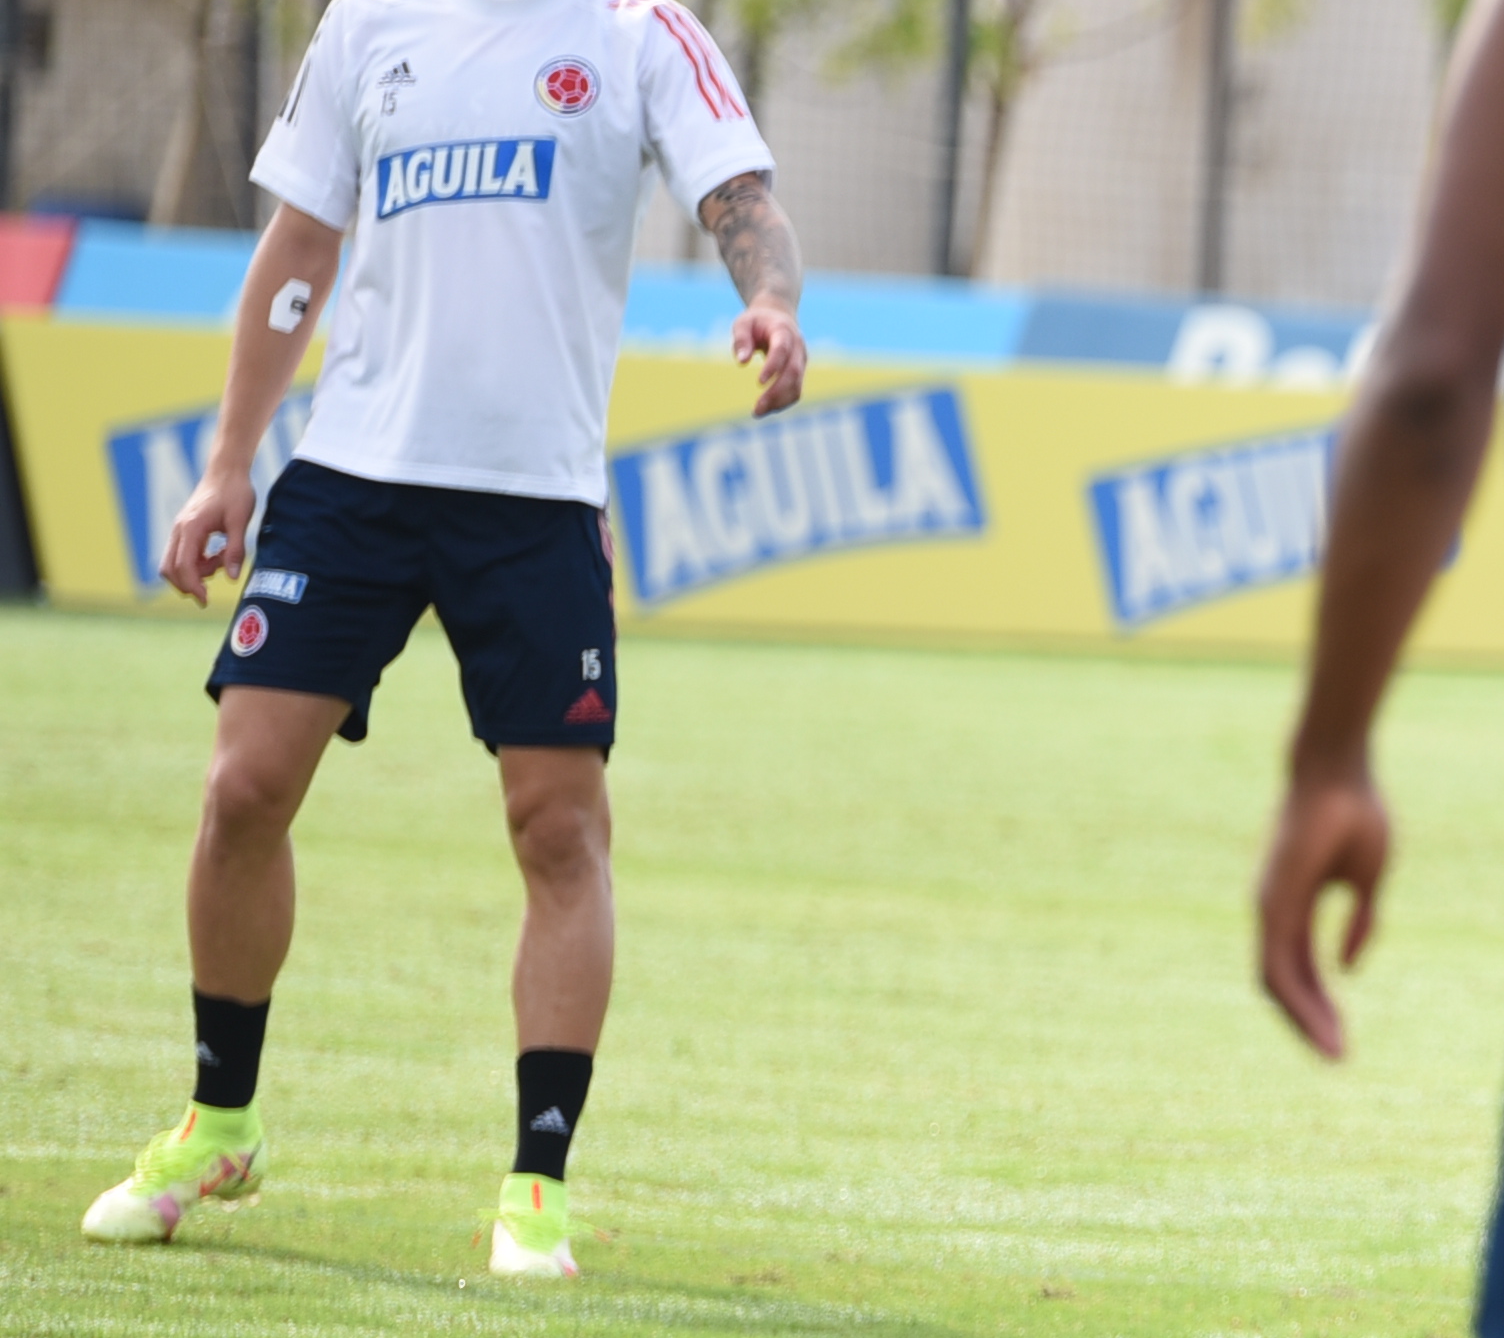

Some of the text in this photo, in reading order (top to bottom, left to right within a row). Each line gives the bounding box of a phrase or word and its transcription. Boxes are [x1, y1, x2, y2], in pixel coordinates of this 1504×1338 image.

[382, 141, 540, 217] AGUILA
[643, 399, 972, 583] AGUILA
[581, 648, 602, 681] 15
